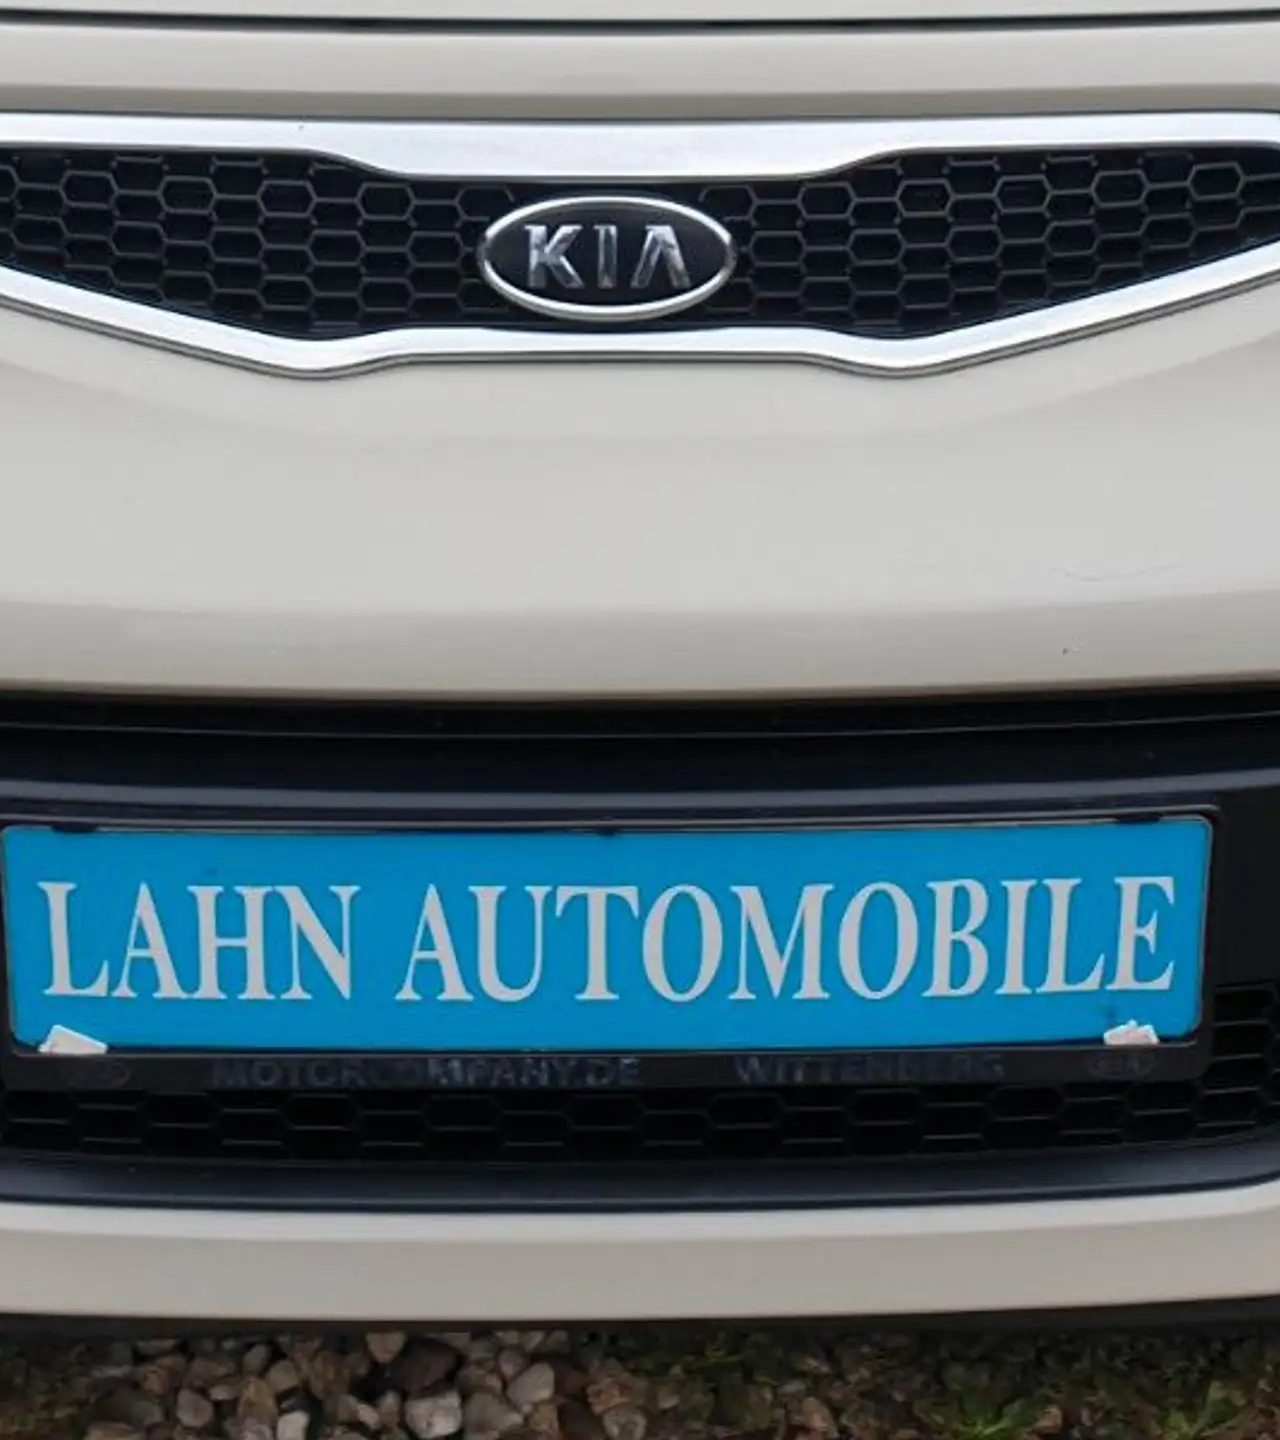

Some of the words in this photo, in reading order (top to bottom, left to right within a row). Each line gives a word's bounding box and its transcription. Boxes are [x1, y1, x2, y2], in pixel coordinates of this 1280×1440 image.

[524, 224, 691, 289] KIA
[37, 880, 361, 1001] LAHN
[394, 875, 1175, 1003] AUTOMOBILE
